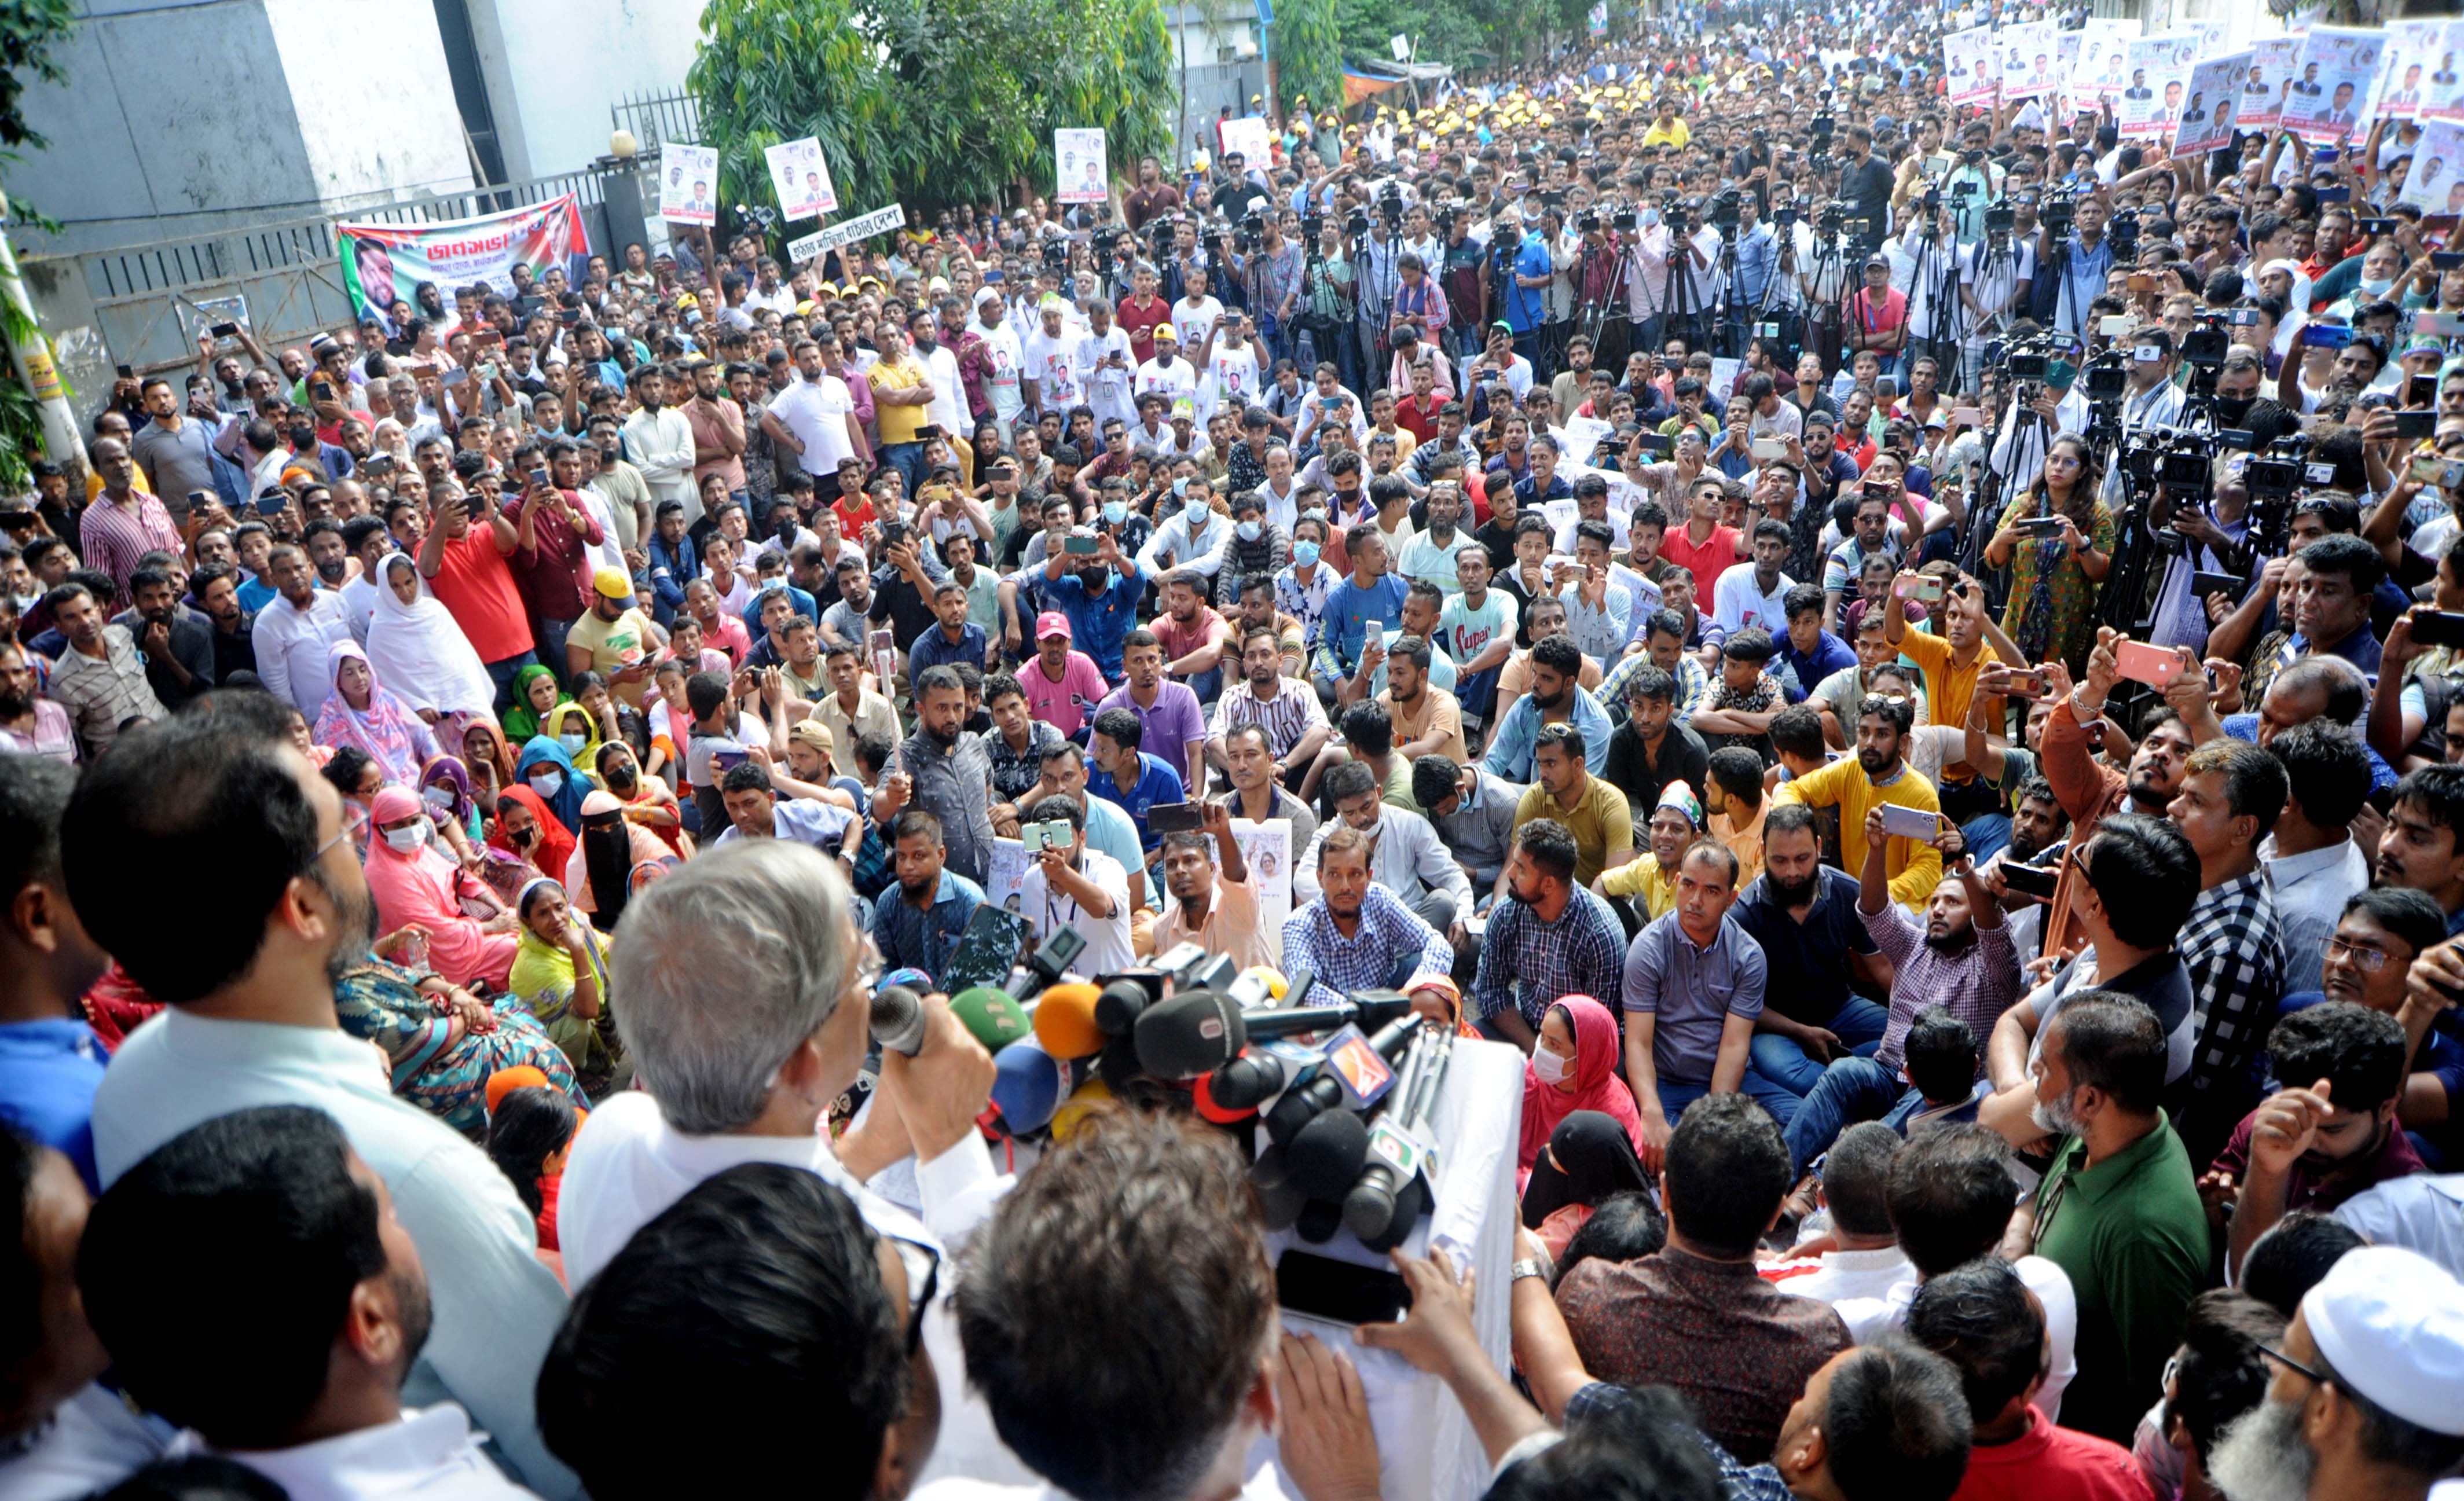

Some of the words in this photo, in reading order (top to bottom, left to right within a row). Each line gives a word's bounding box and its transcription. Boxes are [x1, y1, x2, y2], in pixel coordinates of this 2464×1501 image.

[874, 209, 899, 230] দেশ
[427, 234, 508, 261] জনসভা
[1455, 624, 1491, 659] Super
